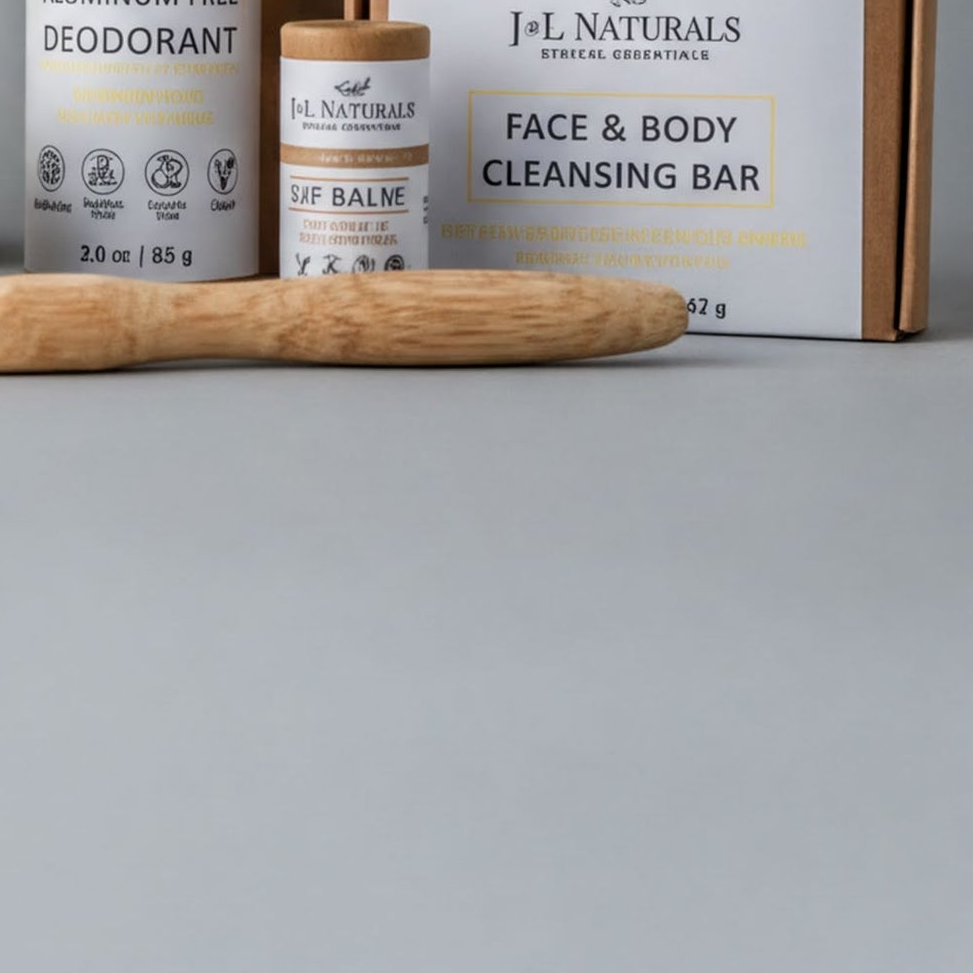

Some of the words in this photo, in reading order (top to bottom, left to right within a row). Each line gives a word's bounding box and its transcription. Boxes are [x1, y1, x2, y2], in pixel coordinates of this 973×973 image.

[43, 24, 238, 55] DEODORANT
[574, 12, 741, 43] NATURALS
[321, 99, 416, 120] NATURALS
[506, 112, 588, 141] FACE
[601, 113, 627, 142] &
[641, 115, 738, 144] BODY
[481, 158, 677, 191] CLEANSING
[692, 163, 760, 192] BAR
[151, 246, 176, 265] 85
[181, 249, 193, 268] g
[715, 303, 727, 320] g
